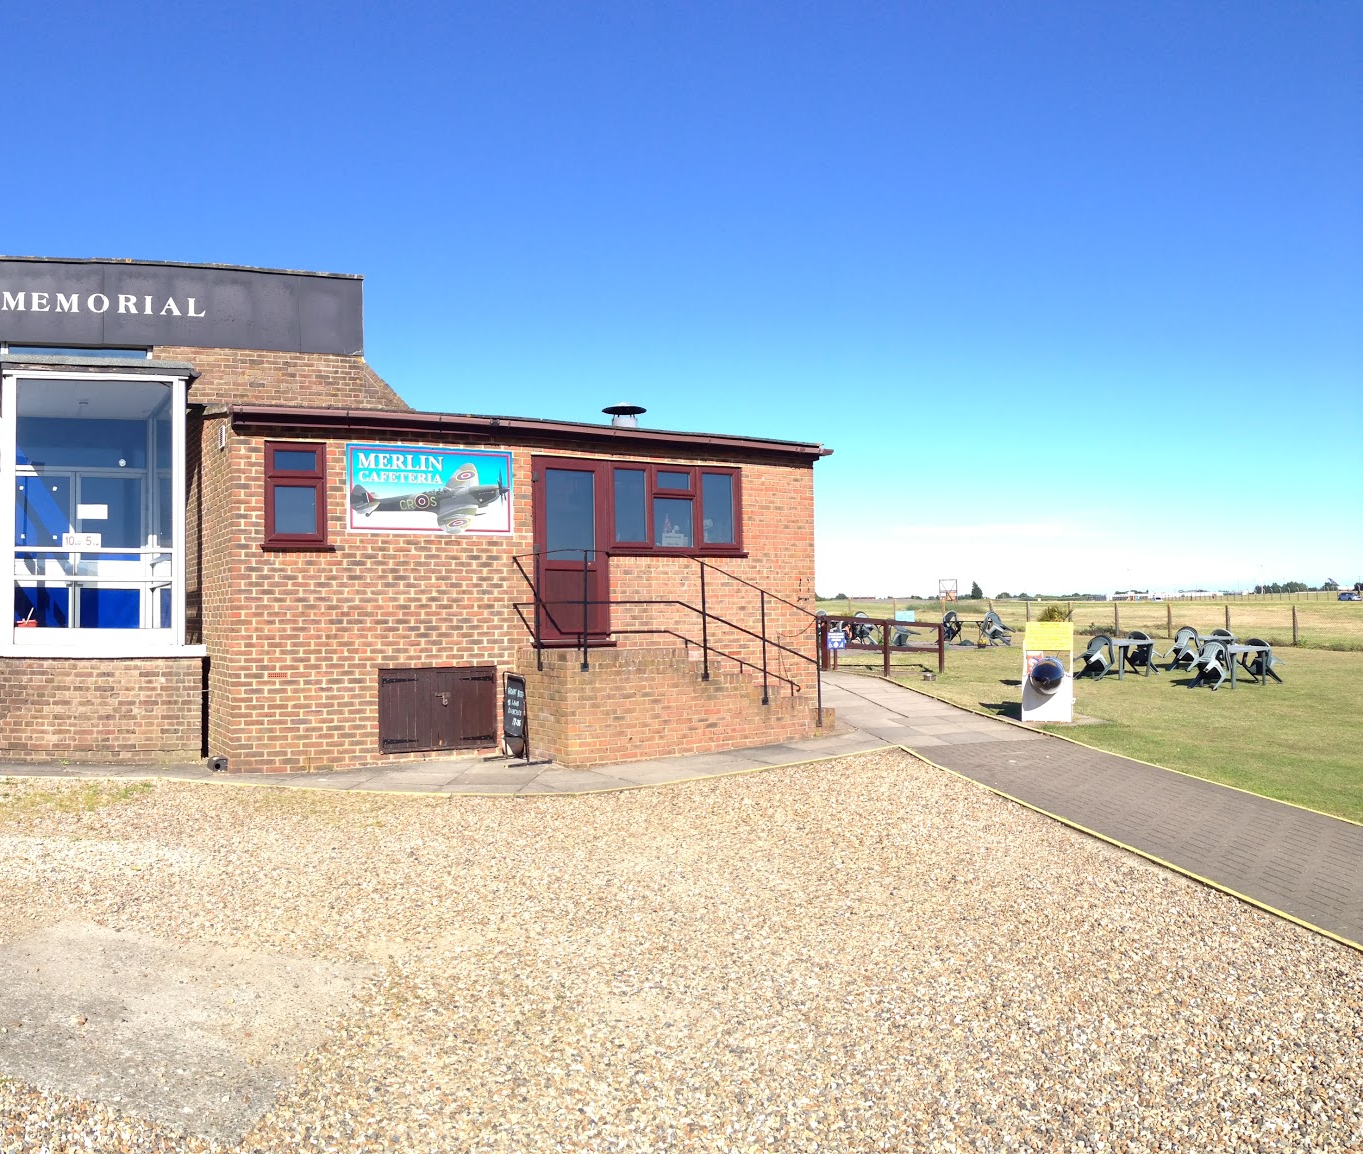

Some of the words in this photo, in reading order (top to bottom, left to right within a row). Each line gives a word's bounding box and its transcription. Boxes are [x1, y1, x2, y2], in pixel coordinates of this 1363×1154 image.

[1, 291, 206, 317] MEMORIAL
[357, 452, 444, 472] MERLIN
[358, 470, 443, 485] CAFETERIA
